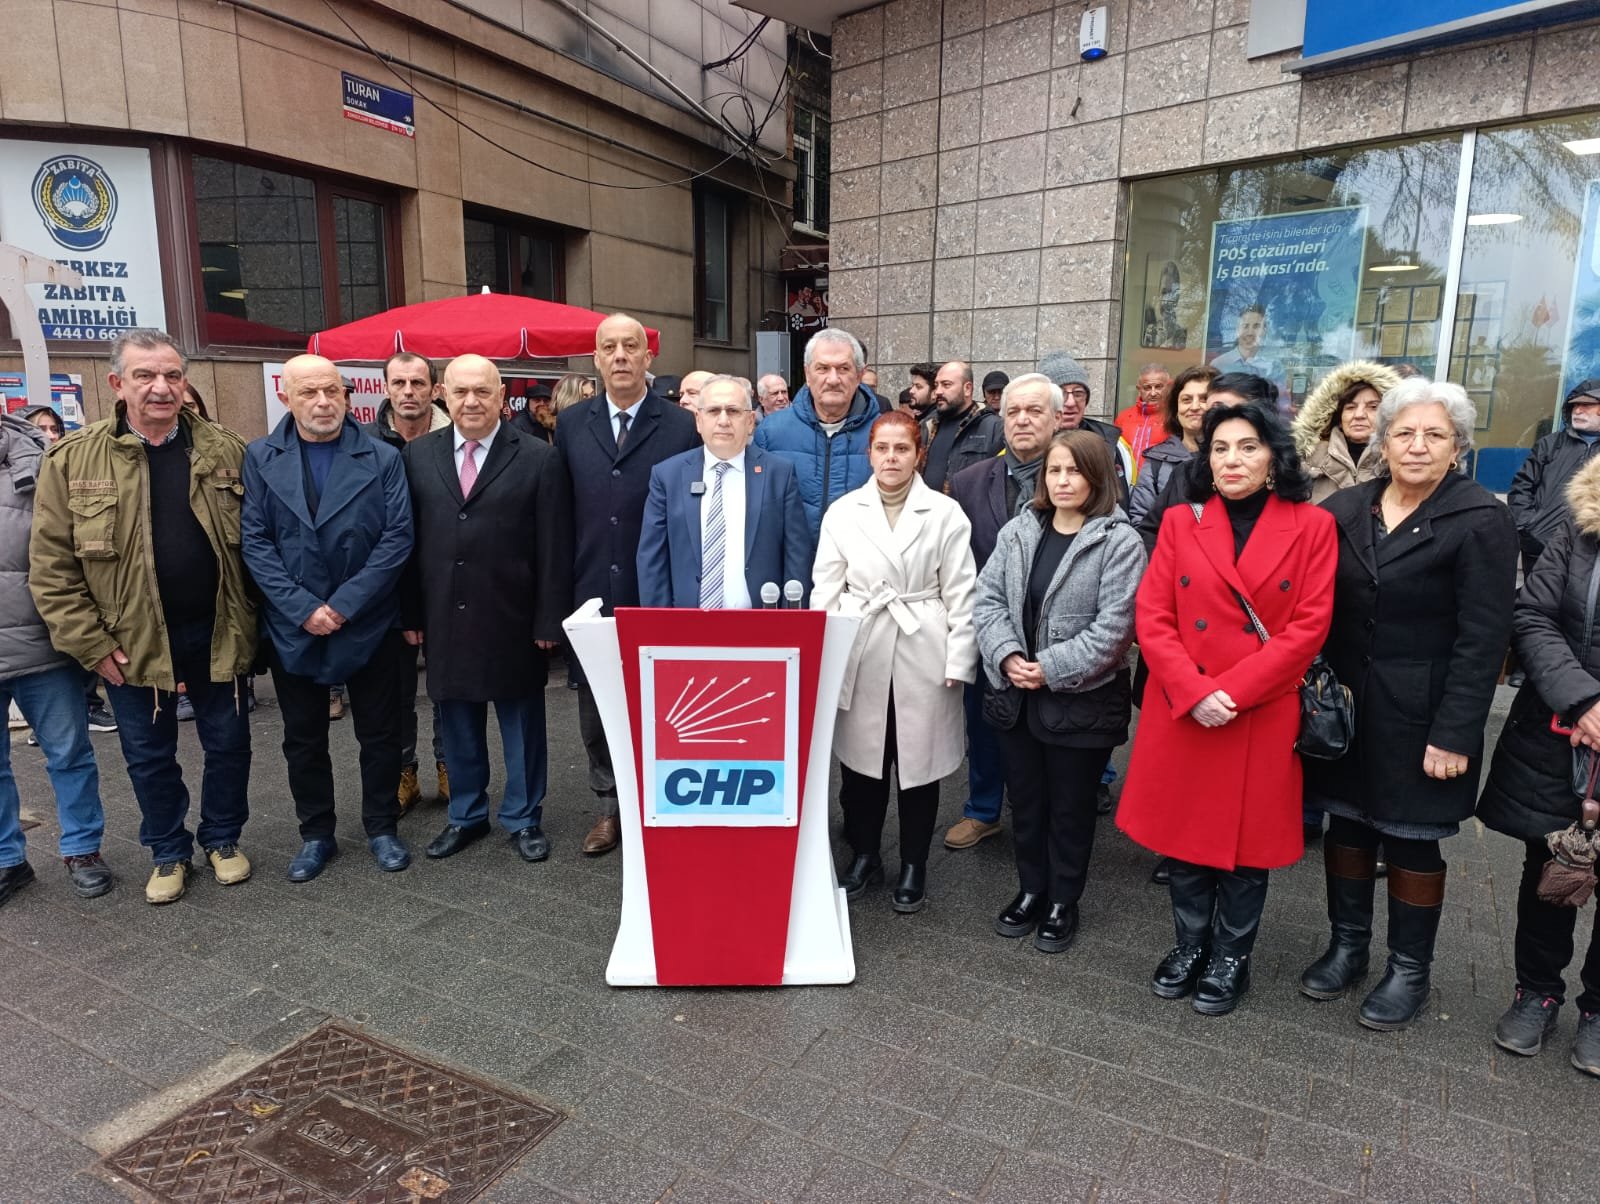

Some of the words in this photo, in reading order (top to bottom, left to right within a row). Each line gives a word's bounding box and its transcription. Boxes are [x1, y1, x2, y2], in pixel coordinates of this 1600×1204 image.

[346, 79, 380, 103] TURAN
[50, 160, 96, 178] ZABITA
[1263, 229, 1281, 240] işini
[1284, 225, 1321, 238] bilenler
[1323, 223, 1342, 236] için
[1218, 246, 1247, 261] POS
[1250, 238, 1327, 261] çözümleri
[1216, 263, 1230, 281] İş
[1231, 258, 1329, 278] Bankası'nda.
[44, 284, 126, 302] ZABITA
[38, 304, 137, 327] AMİRLİĞİ
[53, 327, 82, 339] 444
[85, 328, 95, 339] 0
[664, 768, 775, 806] CHP
